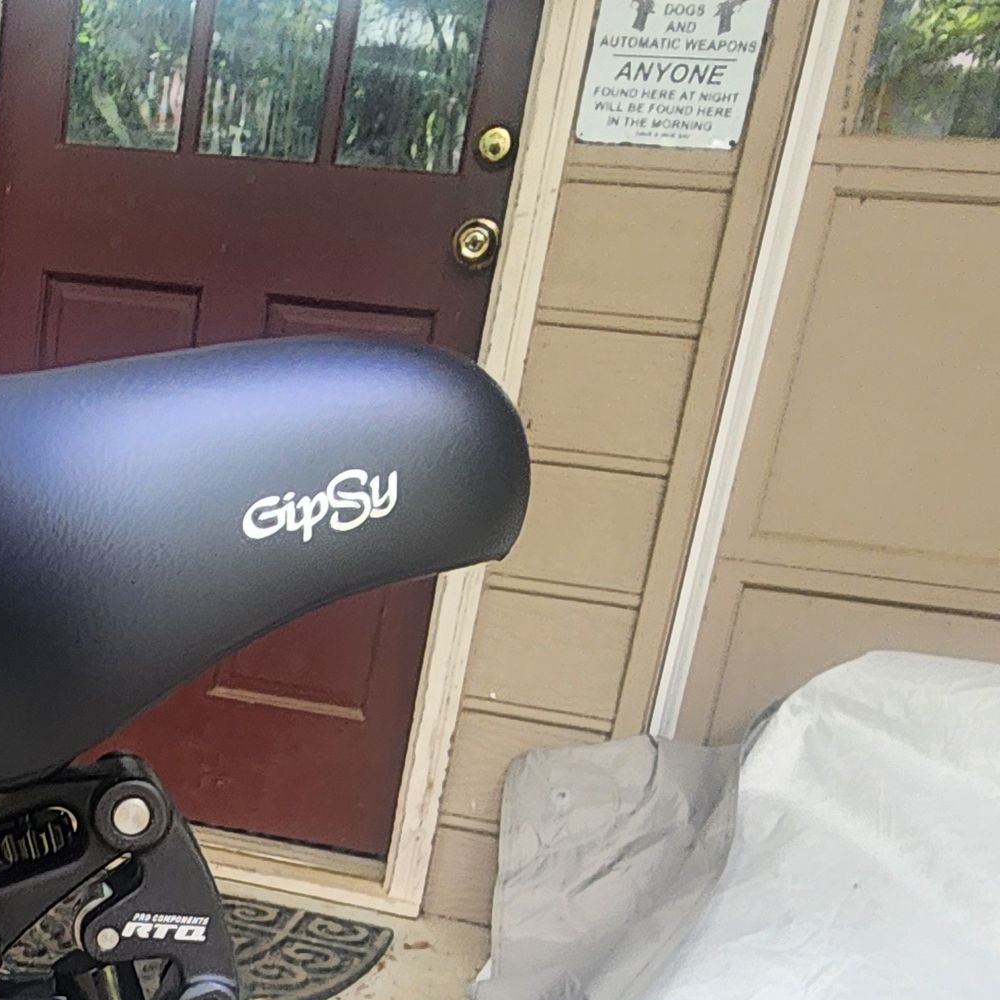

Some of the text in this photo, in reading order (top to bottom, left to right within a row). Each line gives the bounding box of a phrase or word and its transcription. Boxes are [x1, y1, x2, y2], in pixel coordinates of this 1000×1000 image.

[664, 3, 705, 16] DOGS
[665, 21, 697, 33] AND
[600, 35, 757, 53] AUTOMATIC WEAPONS
[614, 61, 728, 86] ANYONE
[593, 86, 739, 104] FOUND HERE AT NIGHT
[595, 101, 733, 118] WILL BE FOUND HERE
[606, 116, 712, 132] IN THE MORNING
[242, 468, 398, 543] GipSy
[132, 912, 210, 925] PRO COMPONENTS
